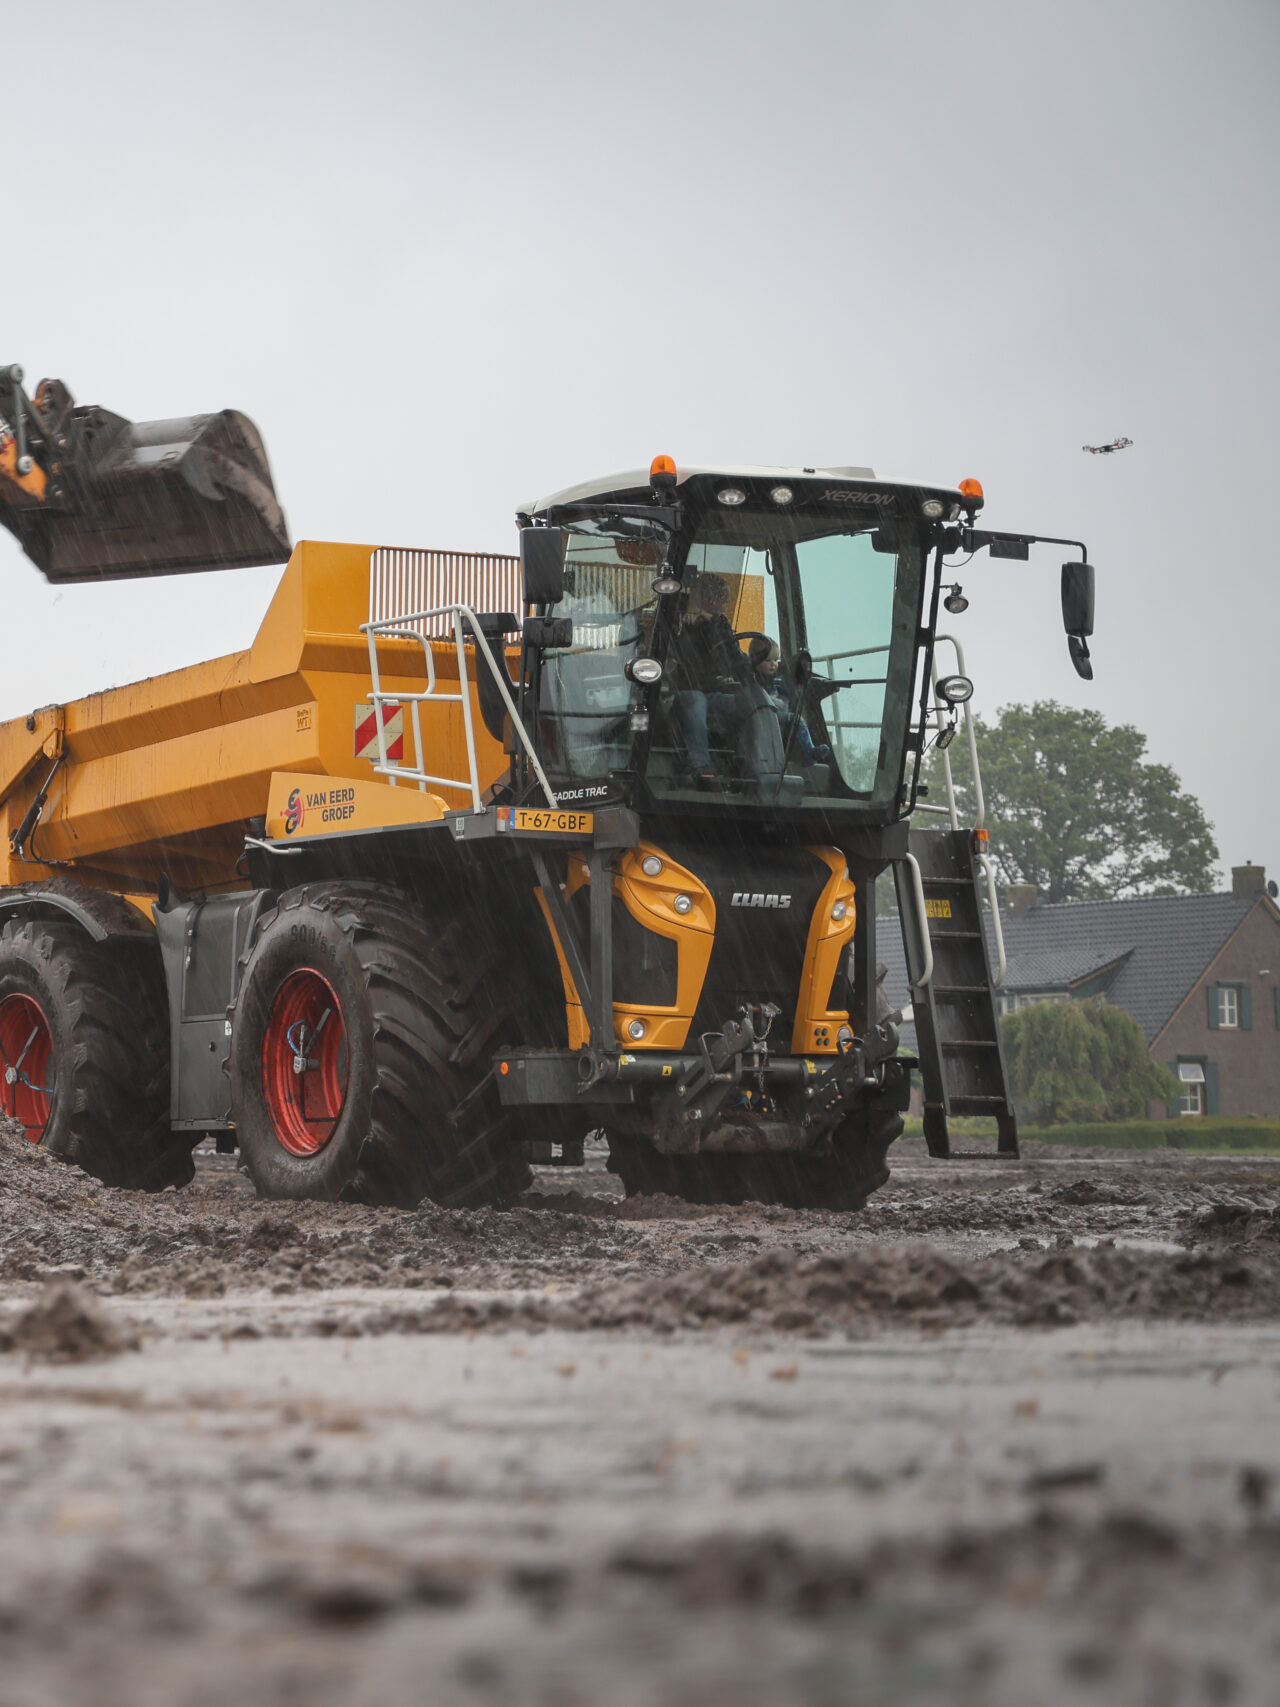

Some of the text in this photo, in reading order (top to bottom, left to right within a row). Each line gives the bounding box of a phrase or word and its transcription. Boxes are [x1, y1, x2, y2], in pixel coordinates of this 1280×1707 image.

[818, 489, 896, 505] XERION
[306, 788, 355, 807] VAN EERD
[585, 785, 608, 798] TRAC
[322, 805, 355, 822] GROEP
[519, 812, 587, 830] T-67-GBF
[730, 892, 792, 909] CLAAS
